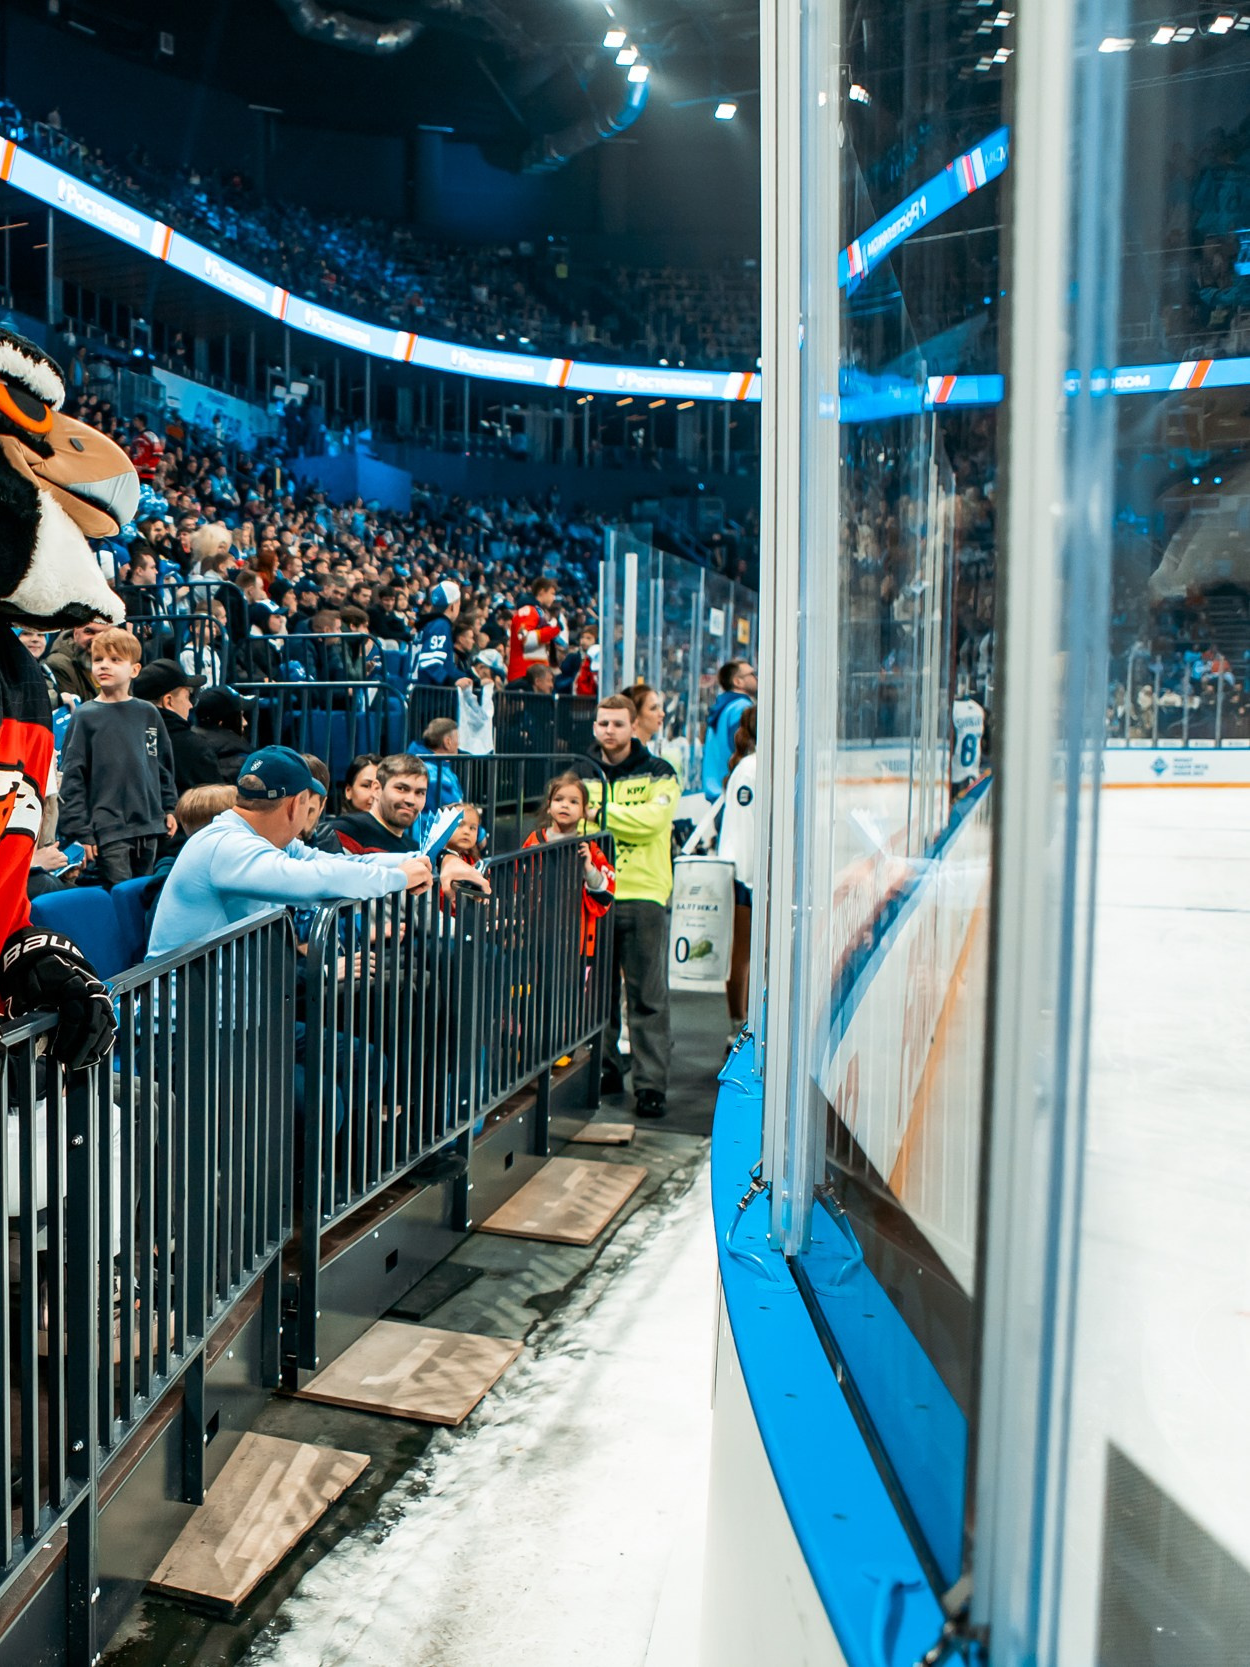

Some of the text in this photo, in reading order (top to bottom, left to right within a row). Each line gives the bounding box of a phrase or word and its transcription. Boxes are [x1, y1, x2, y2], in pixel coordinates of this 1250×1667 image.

[430, 635, 447, 649] 97
[960, 733, 977, 767] 8
[675, 936, 690, 963] 0
